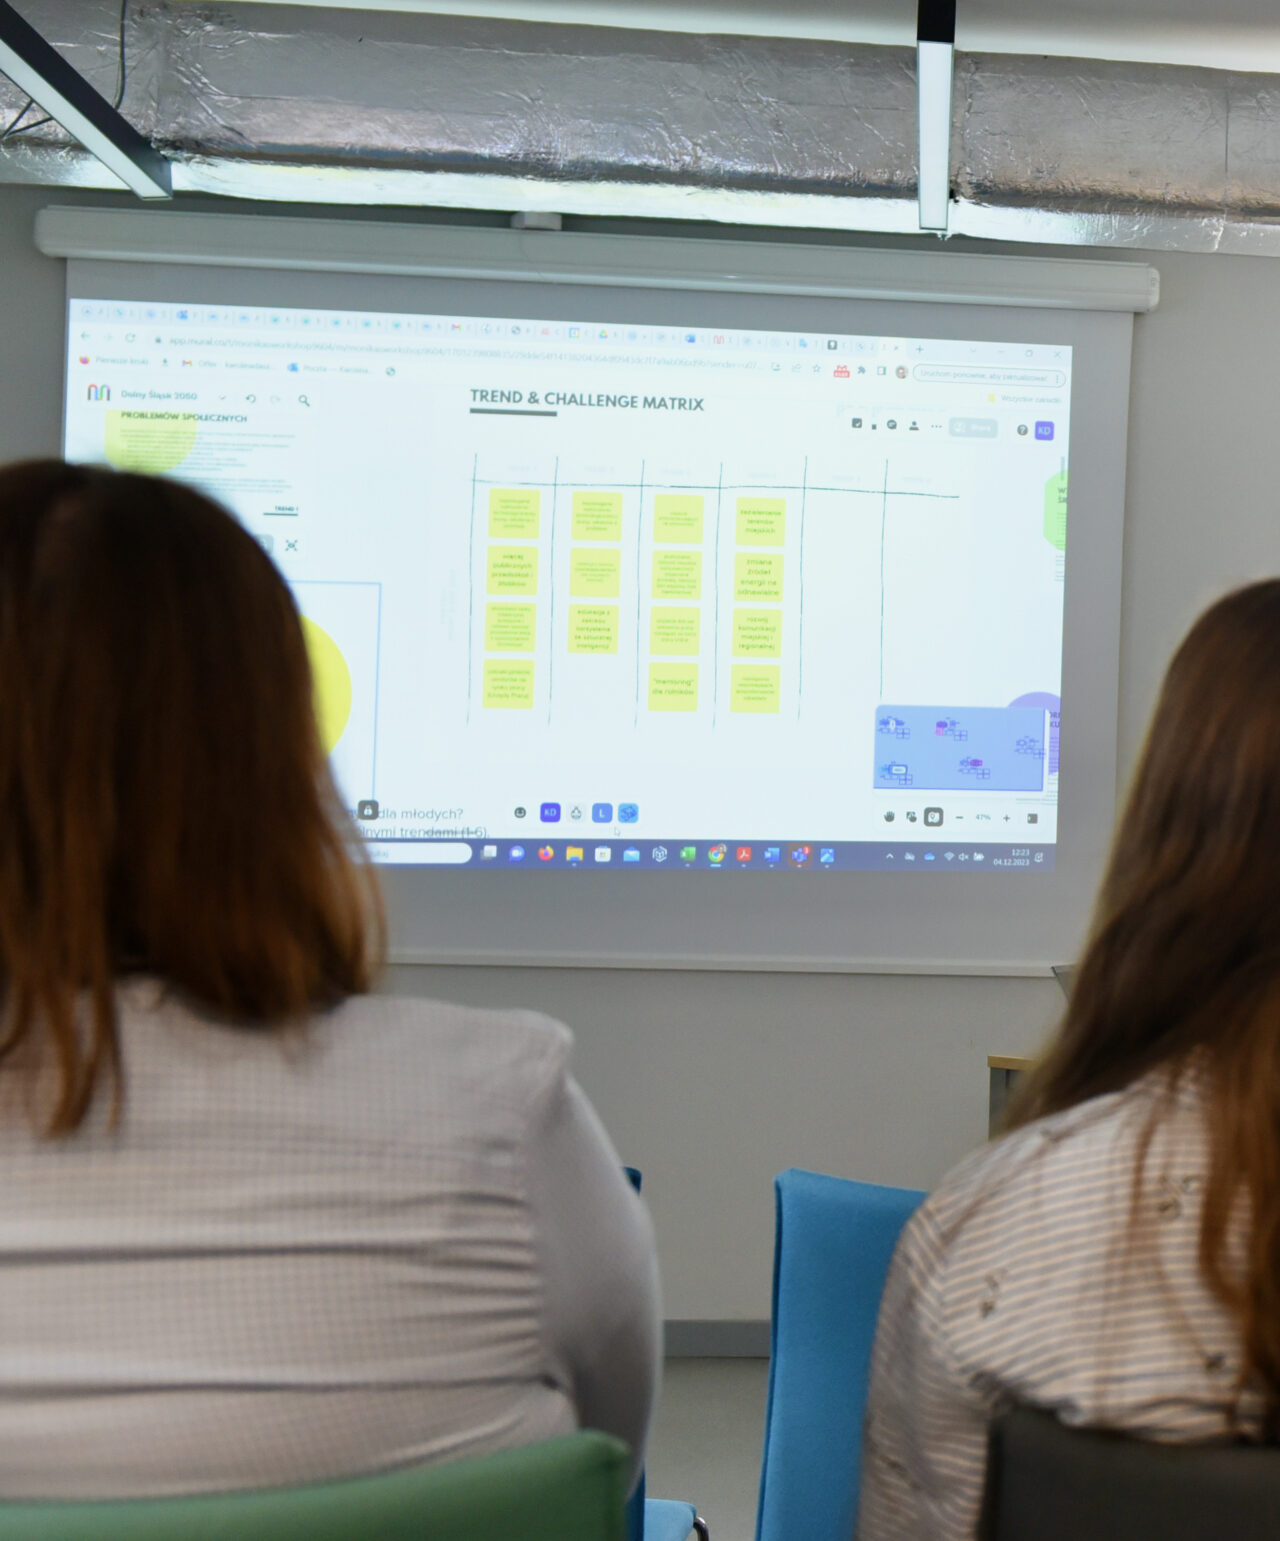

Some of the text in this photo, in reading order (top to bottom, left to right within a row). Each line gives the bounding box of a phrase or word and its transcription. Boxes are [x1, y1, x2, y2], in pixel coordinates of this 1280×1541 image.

[121, 390, 146, 400] Dolny
[148, 389, 173, 401] Śląsk
[470, 389, 705, 412] TREND & CHALLENGE MATRIX
[120, 410, 180, 421] PROBLEMÓW
[378, 808, 464, 822] dla młodych?
